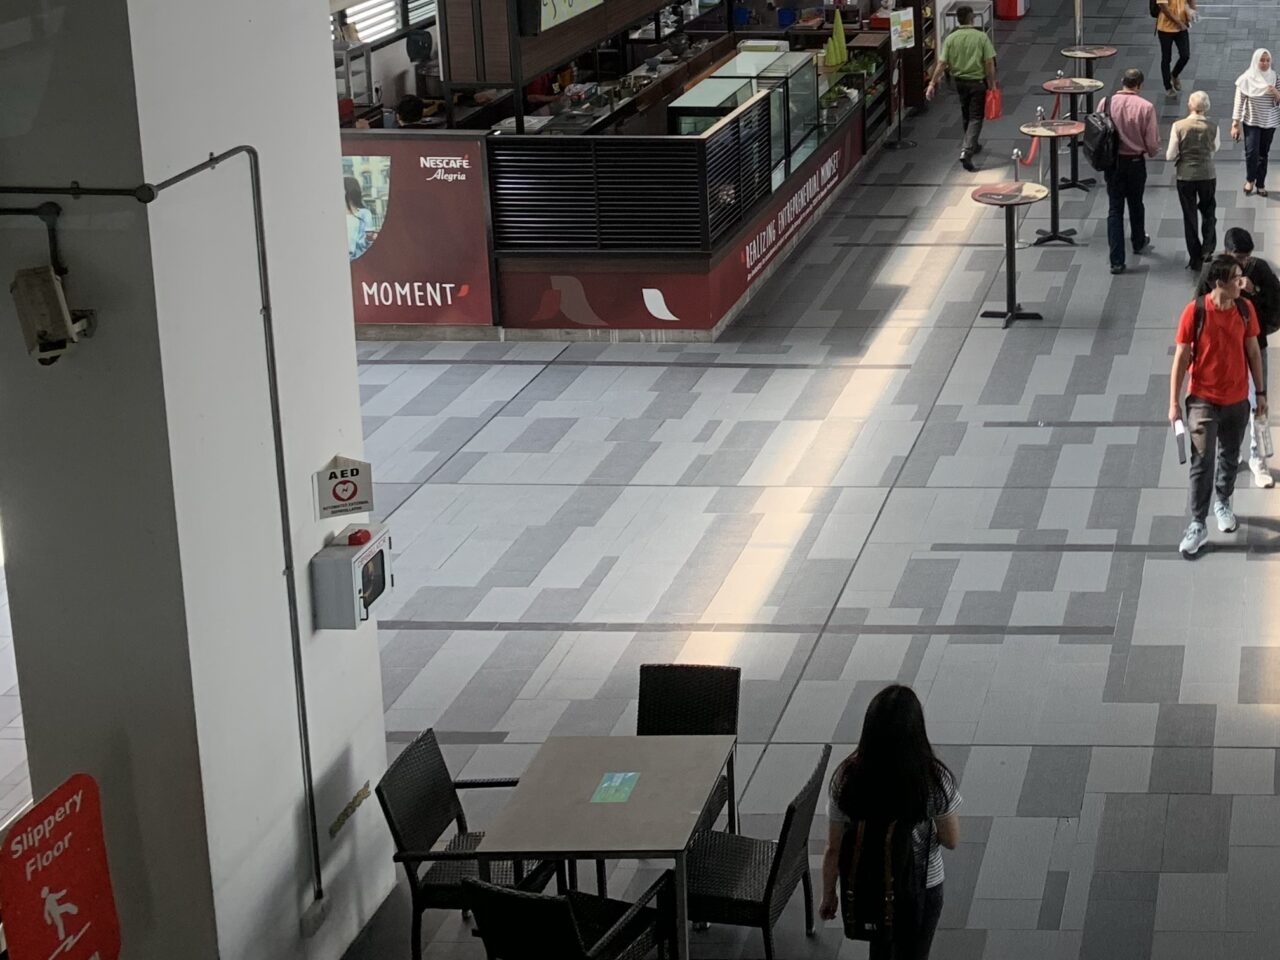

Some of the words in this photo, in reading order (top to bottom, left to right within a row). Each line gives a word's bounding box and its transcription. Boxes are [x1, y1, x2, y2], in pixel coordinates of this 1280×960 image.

[426, 169, 466, 181] Alegria
[361, 282, 455, 306] MOMENT
[328, 468, 360, 480] AED
[11, 790, 83, 859] Slippery
[25, 832, 72, 881] Floor
